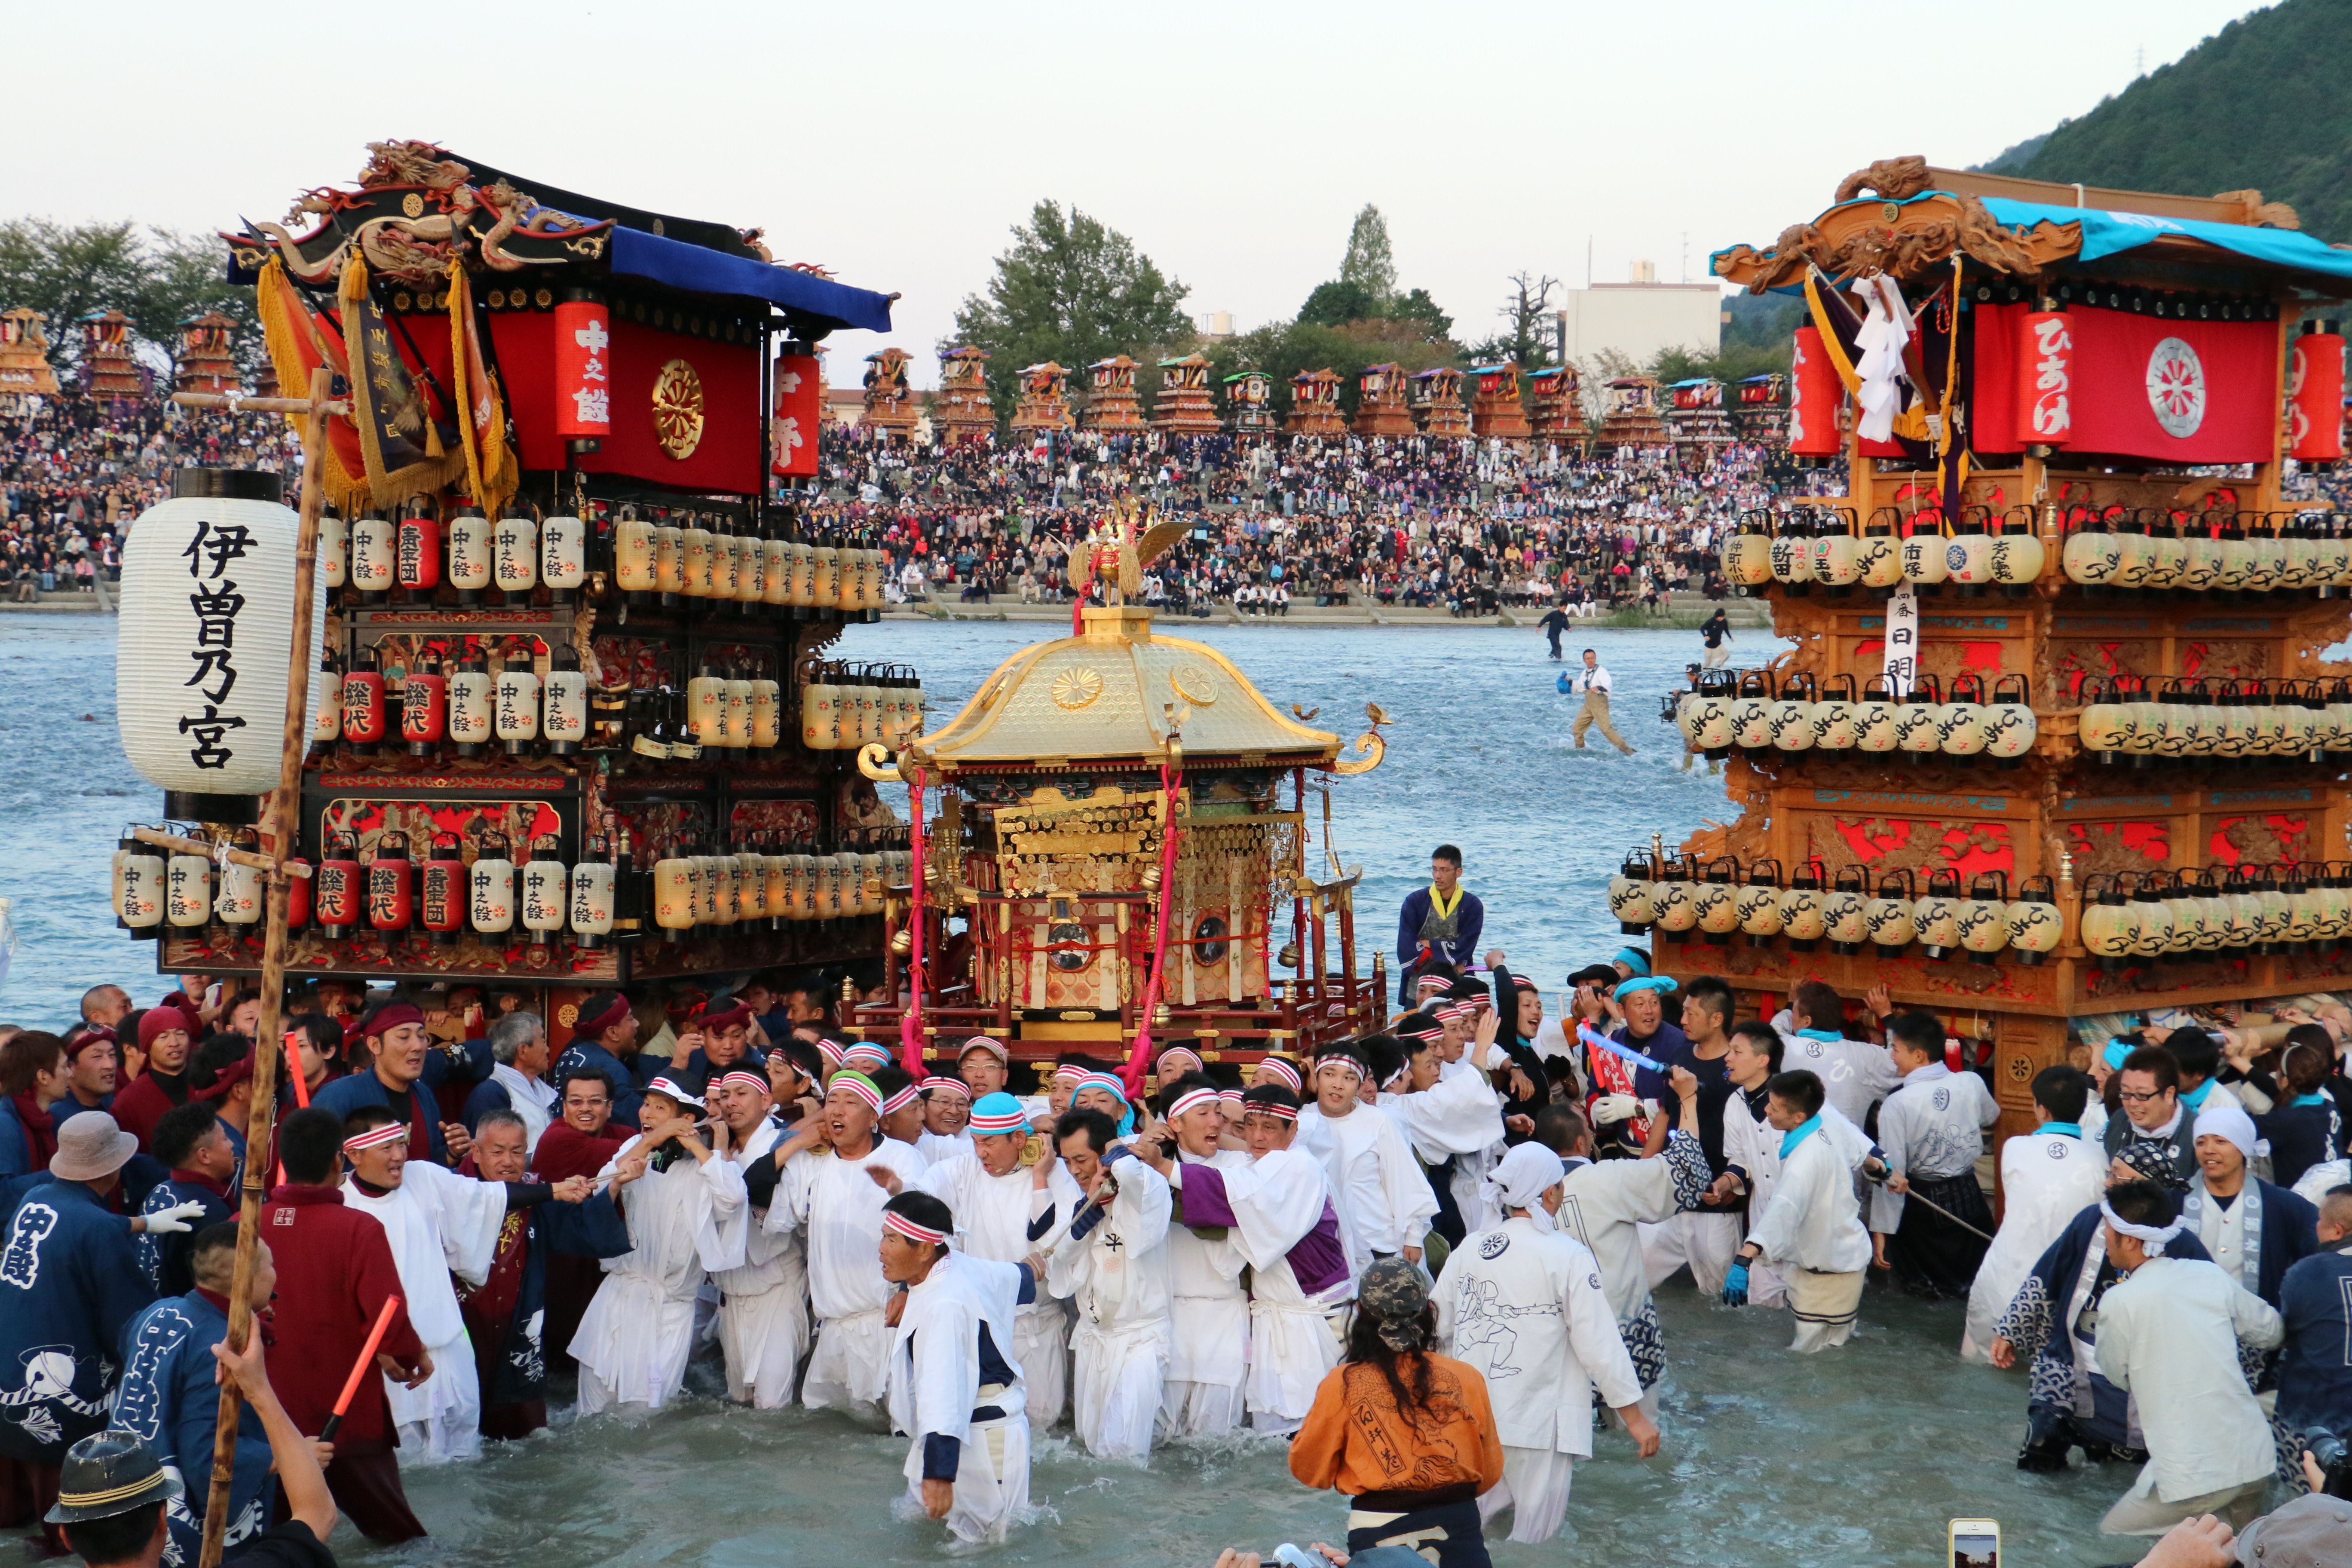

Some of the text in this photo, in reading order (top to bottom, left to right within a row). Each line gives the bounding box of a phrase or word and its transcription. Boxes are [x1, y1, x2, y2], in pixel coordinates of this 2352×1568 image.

[2033, 318, 2073, 434] ひあけ
[1728, 540, 1747, 582] 仲町小川
[1772, 544, 1794, 576] 新田
[1904, 543, 1925, 577] 市塚
[178, 521, 258, 770] 伊曽乃宮
